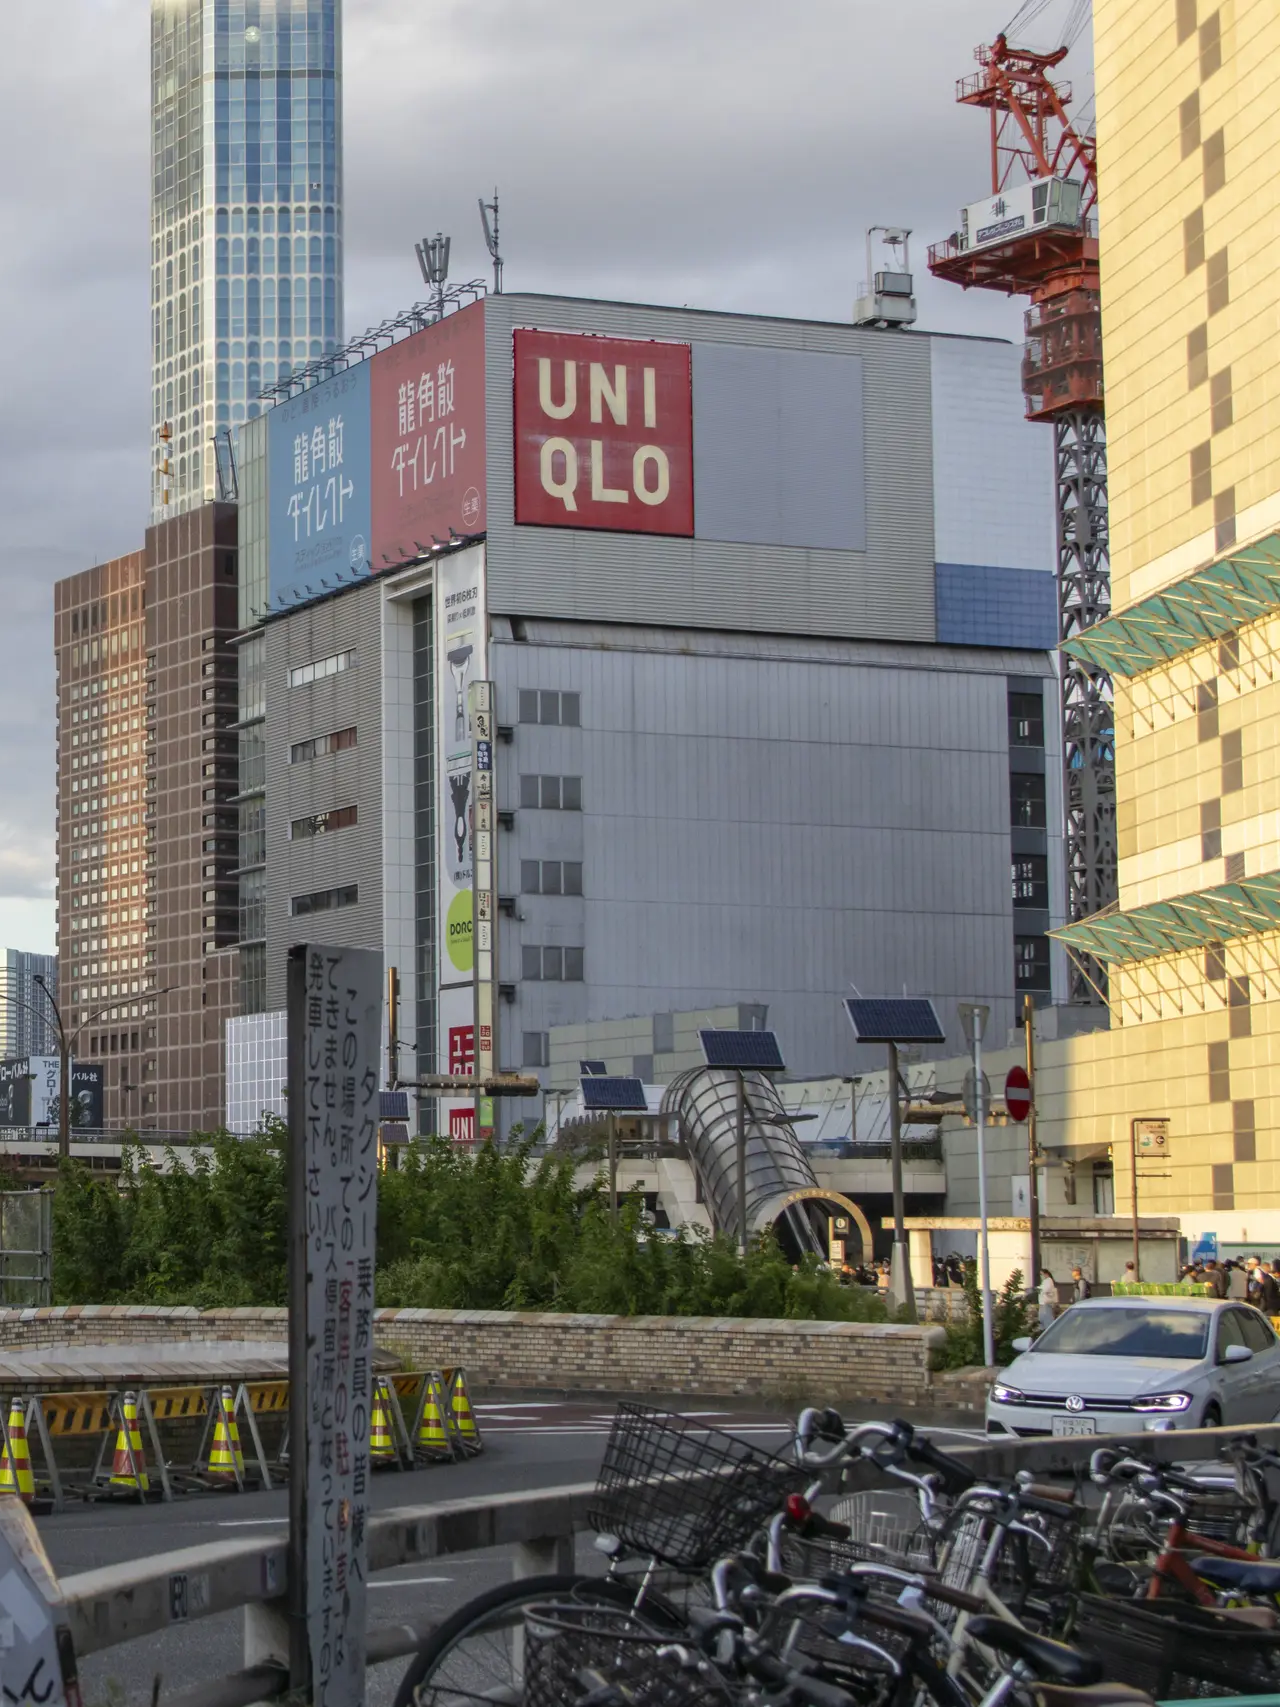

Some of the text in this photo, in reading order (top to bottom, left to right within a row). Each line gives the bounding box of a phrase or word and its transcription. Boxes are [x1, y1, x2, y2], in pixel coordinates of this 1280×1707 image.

[398, 358, 455, 437] 龍角散
[539, 357, 657, 429] UNI
[293, 414, 345, 486] 龍角散
[391, 422, 467, 497] ダイレクト
[540, 437, 670, 512] QLO
[286, 473, 355, 543] ダイレクト
[43, 1060, 60, 1068] THE
